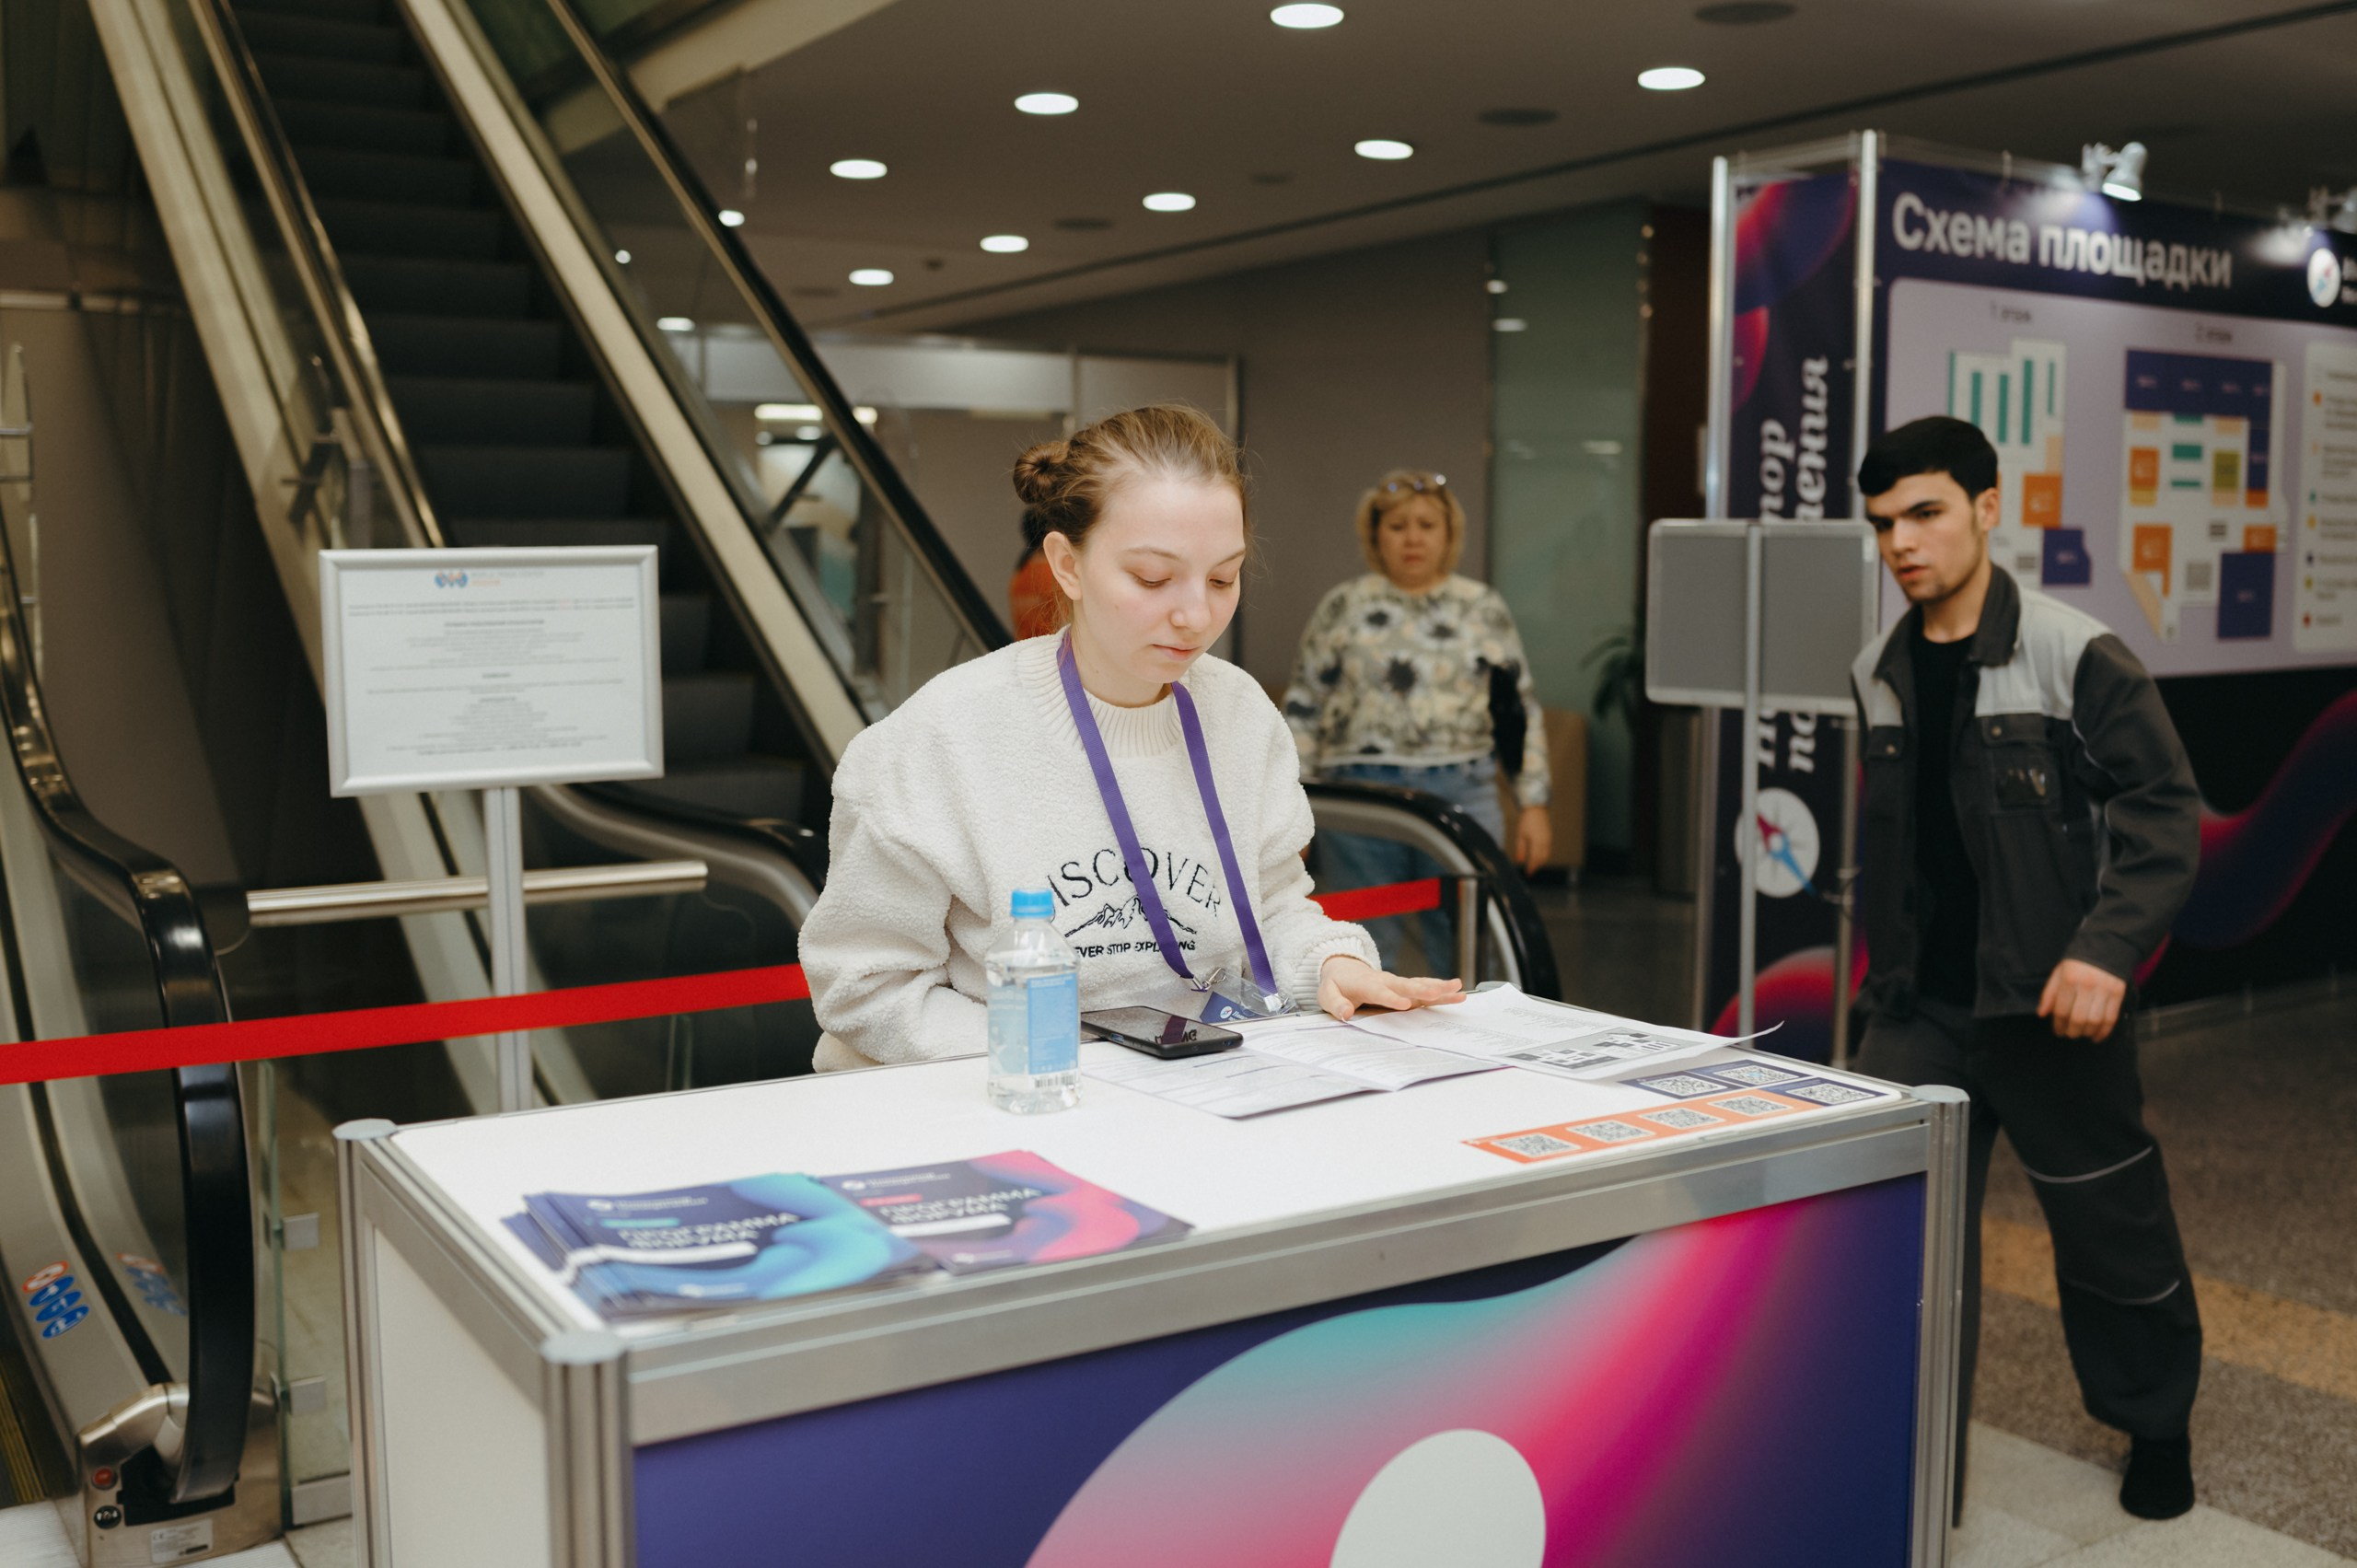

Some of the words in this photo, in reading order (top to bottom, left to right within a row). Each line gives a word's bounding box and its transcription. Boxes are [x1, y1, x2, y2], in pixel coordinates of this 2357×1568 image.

[1892, 192, 2031, 265] Схема
[2038, 224, 2234, 293] площадки
[1048, 847, 1222, 919] ISCOVER
[1106, 942, 1132, 956] STOP
